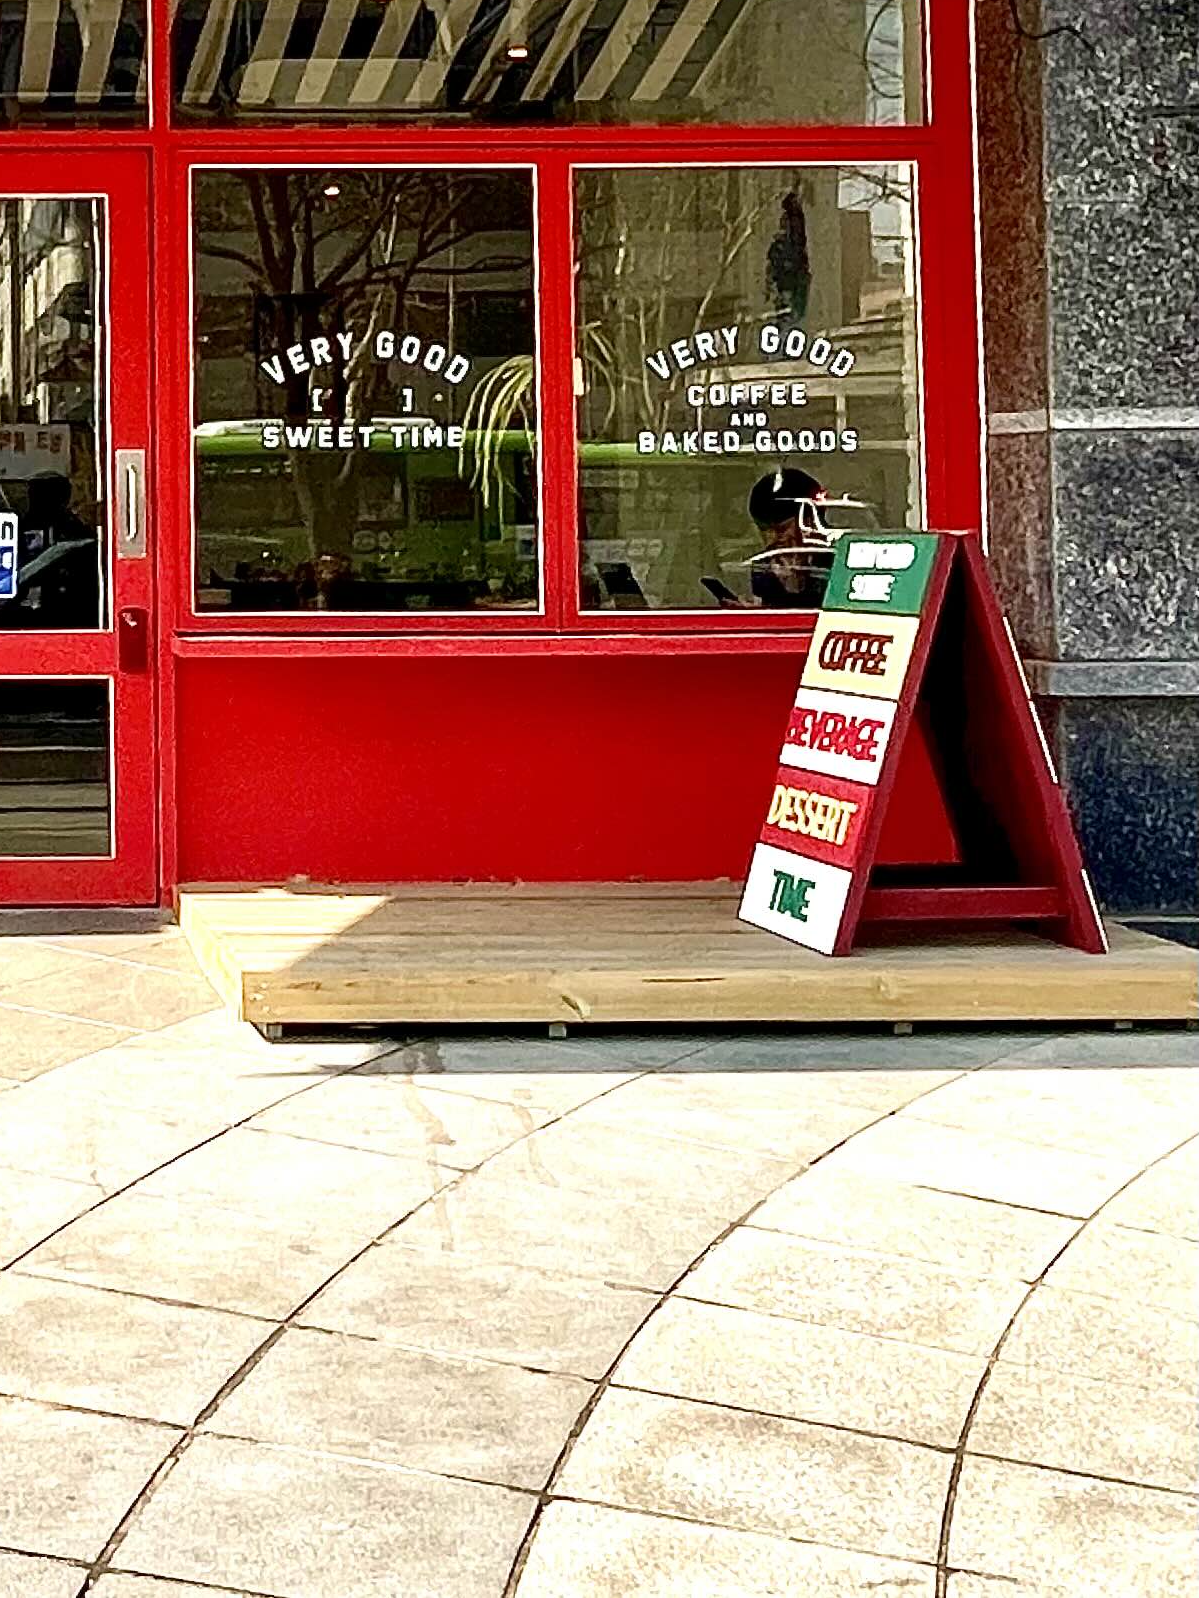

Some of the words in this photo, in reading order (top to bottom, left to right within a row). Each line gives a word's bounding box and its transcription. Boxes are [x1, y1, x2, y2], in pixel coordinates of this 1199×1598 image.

[261, 331, 355, 387] VERY
[376, 330, 472, 386] GOOD
[646, 325, 740, 384] VERY
[759, 324, 857, 379] GOOD
[687, 383, 808, 407] COFFEE
[263, 425, 374, 449] SWEET
[390, 425, 464, 449] TIME
[638, 430, 741, 454] BAKED
[754, 430, 858, 453] GOODS
[730, 412, 768, 427] AND
[819, 630, 894, 676] COFFEE
[785, 706, 885, 762] BEVERAGE
[766, 784, 858, 845] DESSERT
